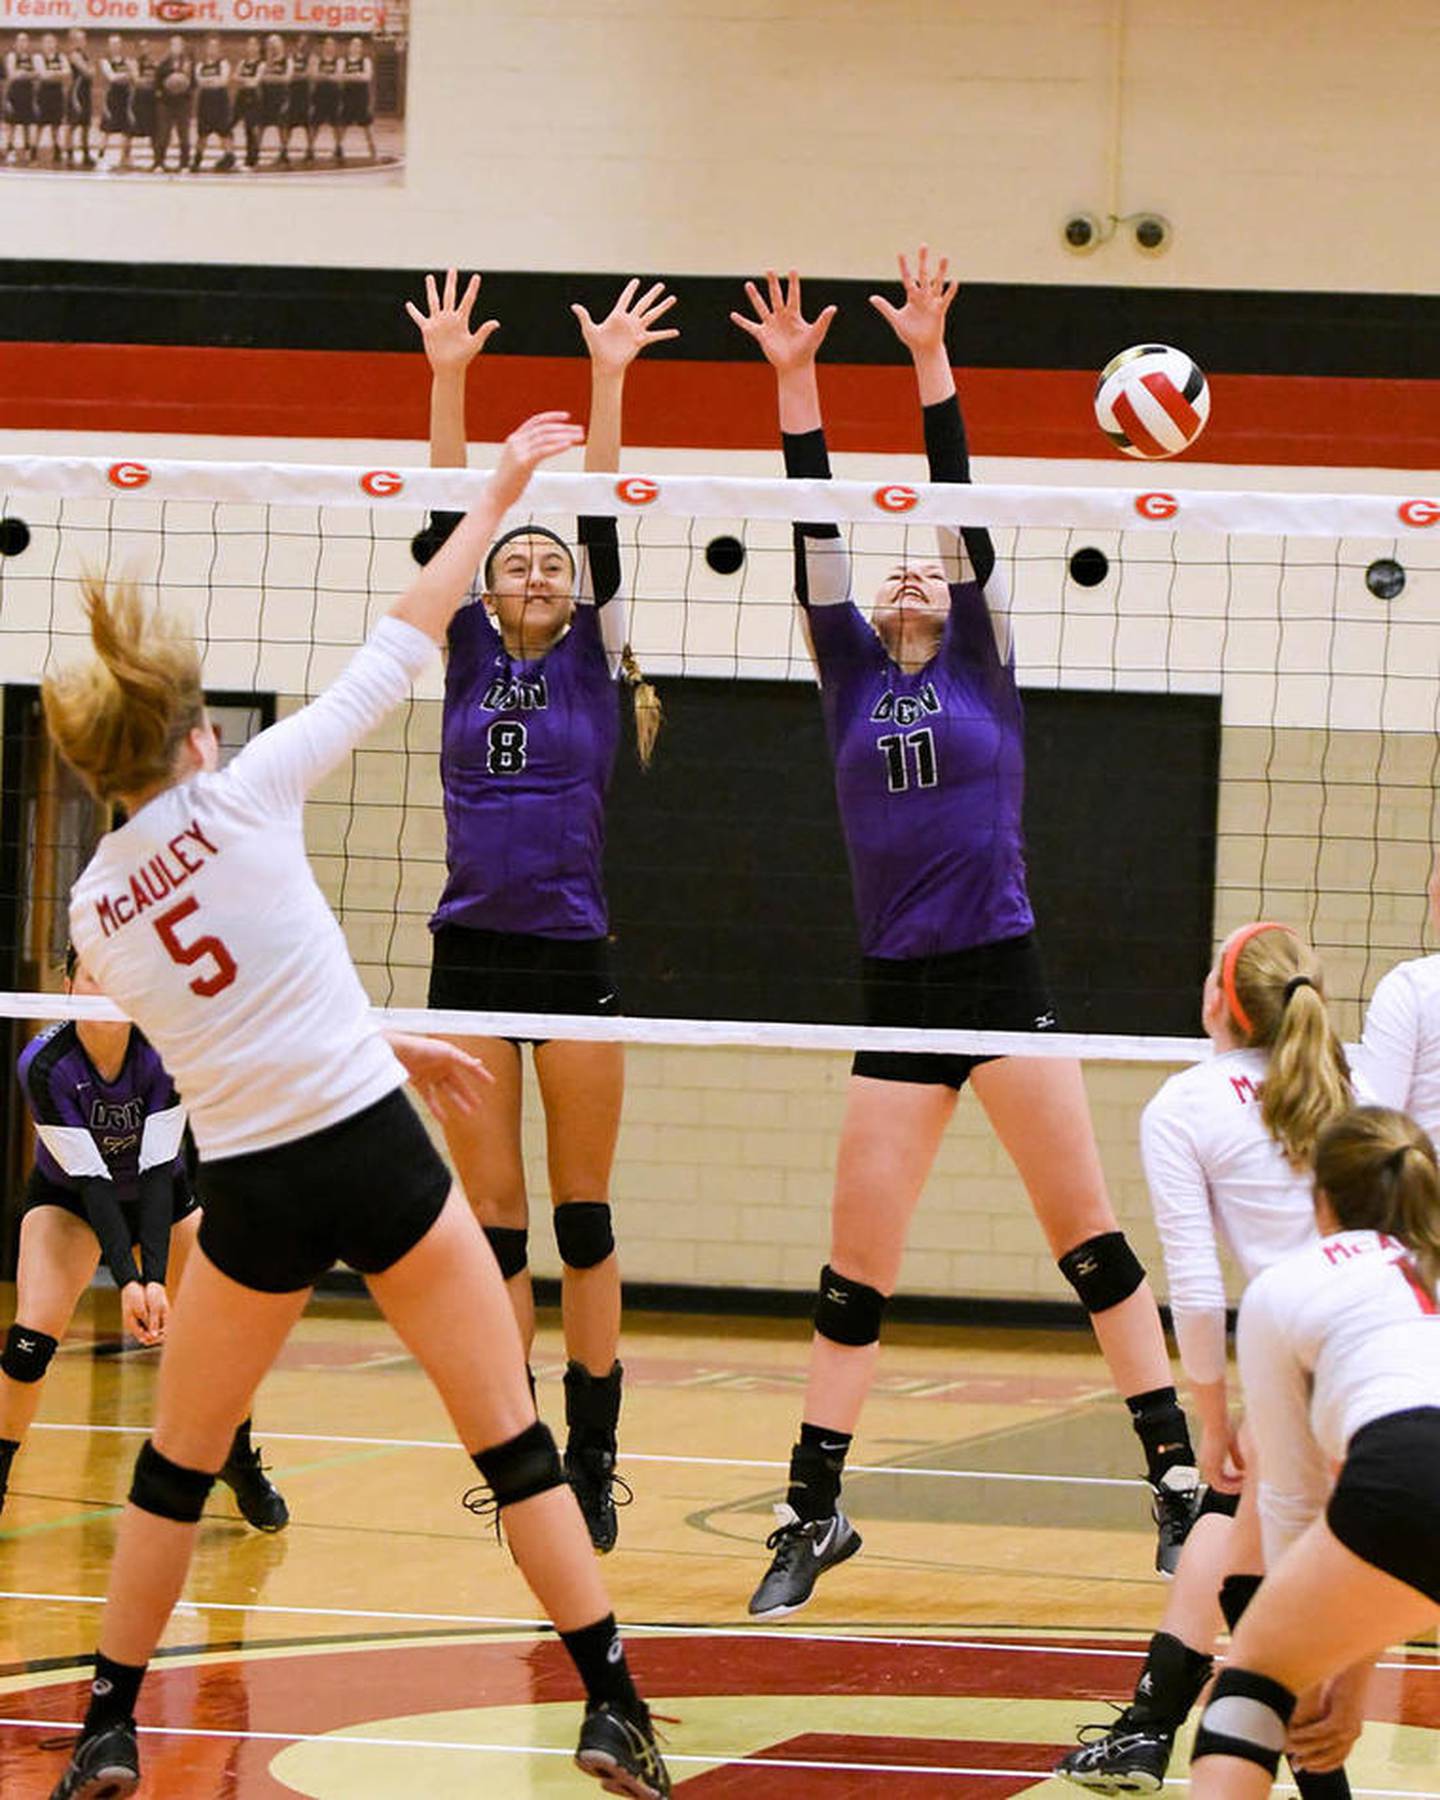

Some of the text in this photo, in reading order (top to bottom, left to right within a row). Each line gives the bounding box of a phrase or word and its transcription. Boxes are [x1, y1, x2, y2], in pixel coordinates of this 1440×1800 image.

[87, 0, 138, 17] One
[233, 0, 285, 21] One
[294, 0, 387, 27] Legacy
[108, 462, 150, 488] G
[360, 470, 403, 496] G
[616, 478, 658, 505] G
[874, 485, 917, 512] G
[1136, 493, 1179, 520] G
[1398, 500, 1440, 527] G
[486, 720, 528, 775] 8
[877, 727, 938, 793] 11
[153, 896, 238, 998] 5
